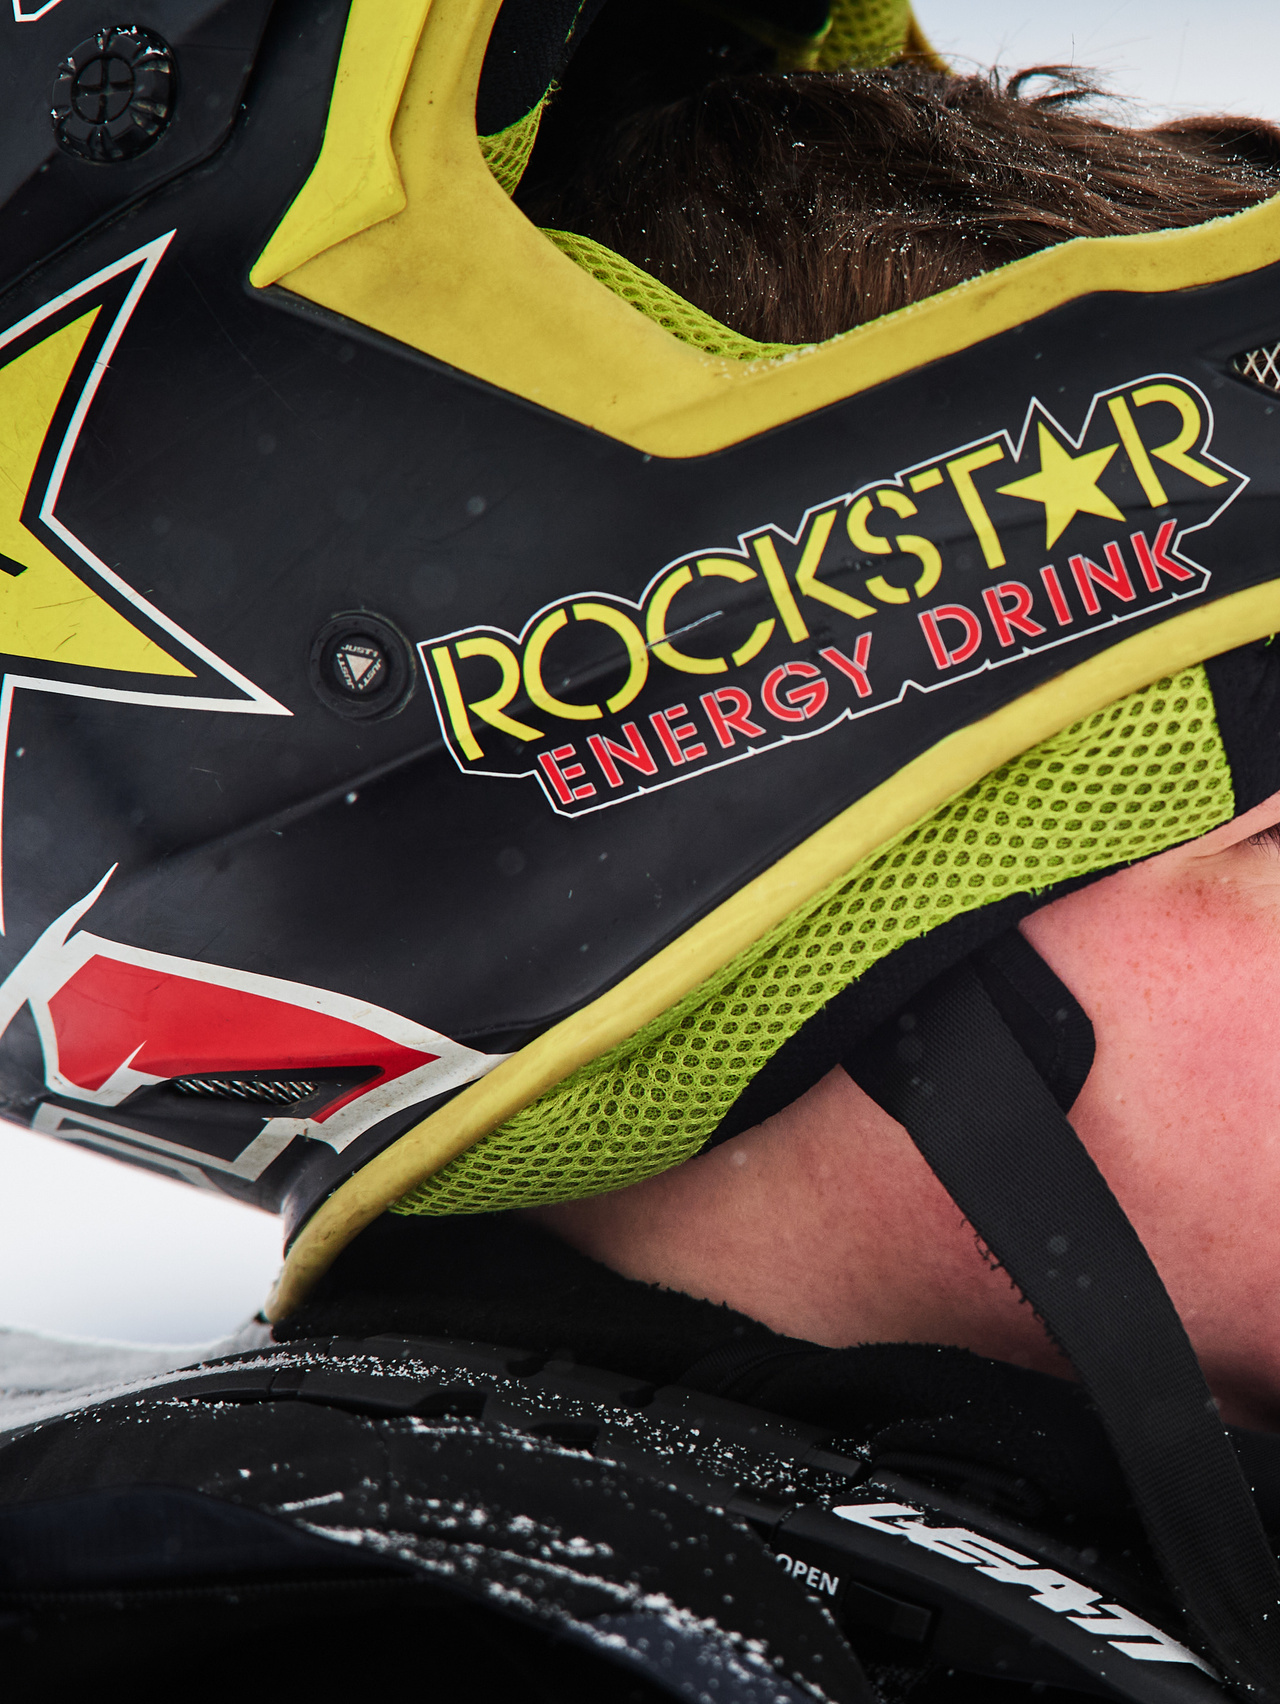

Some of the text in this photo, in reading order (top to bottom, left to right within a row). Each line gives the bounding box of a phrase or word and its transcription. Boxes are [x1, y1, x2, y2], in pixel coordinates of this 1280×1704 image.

[537, 518, 1196, 804] ENERGY DRINK
[775, 1553, 840, 1596] OPEN
